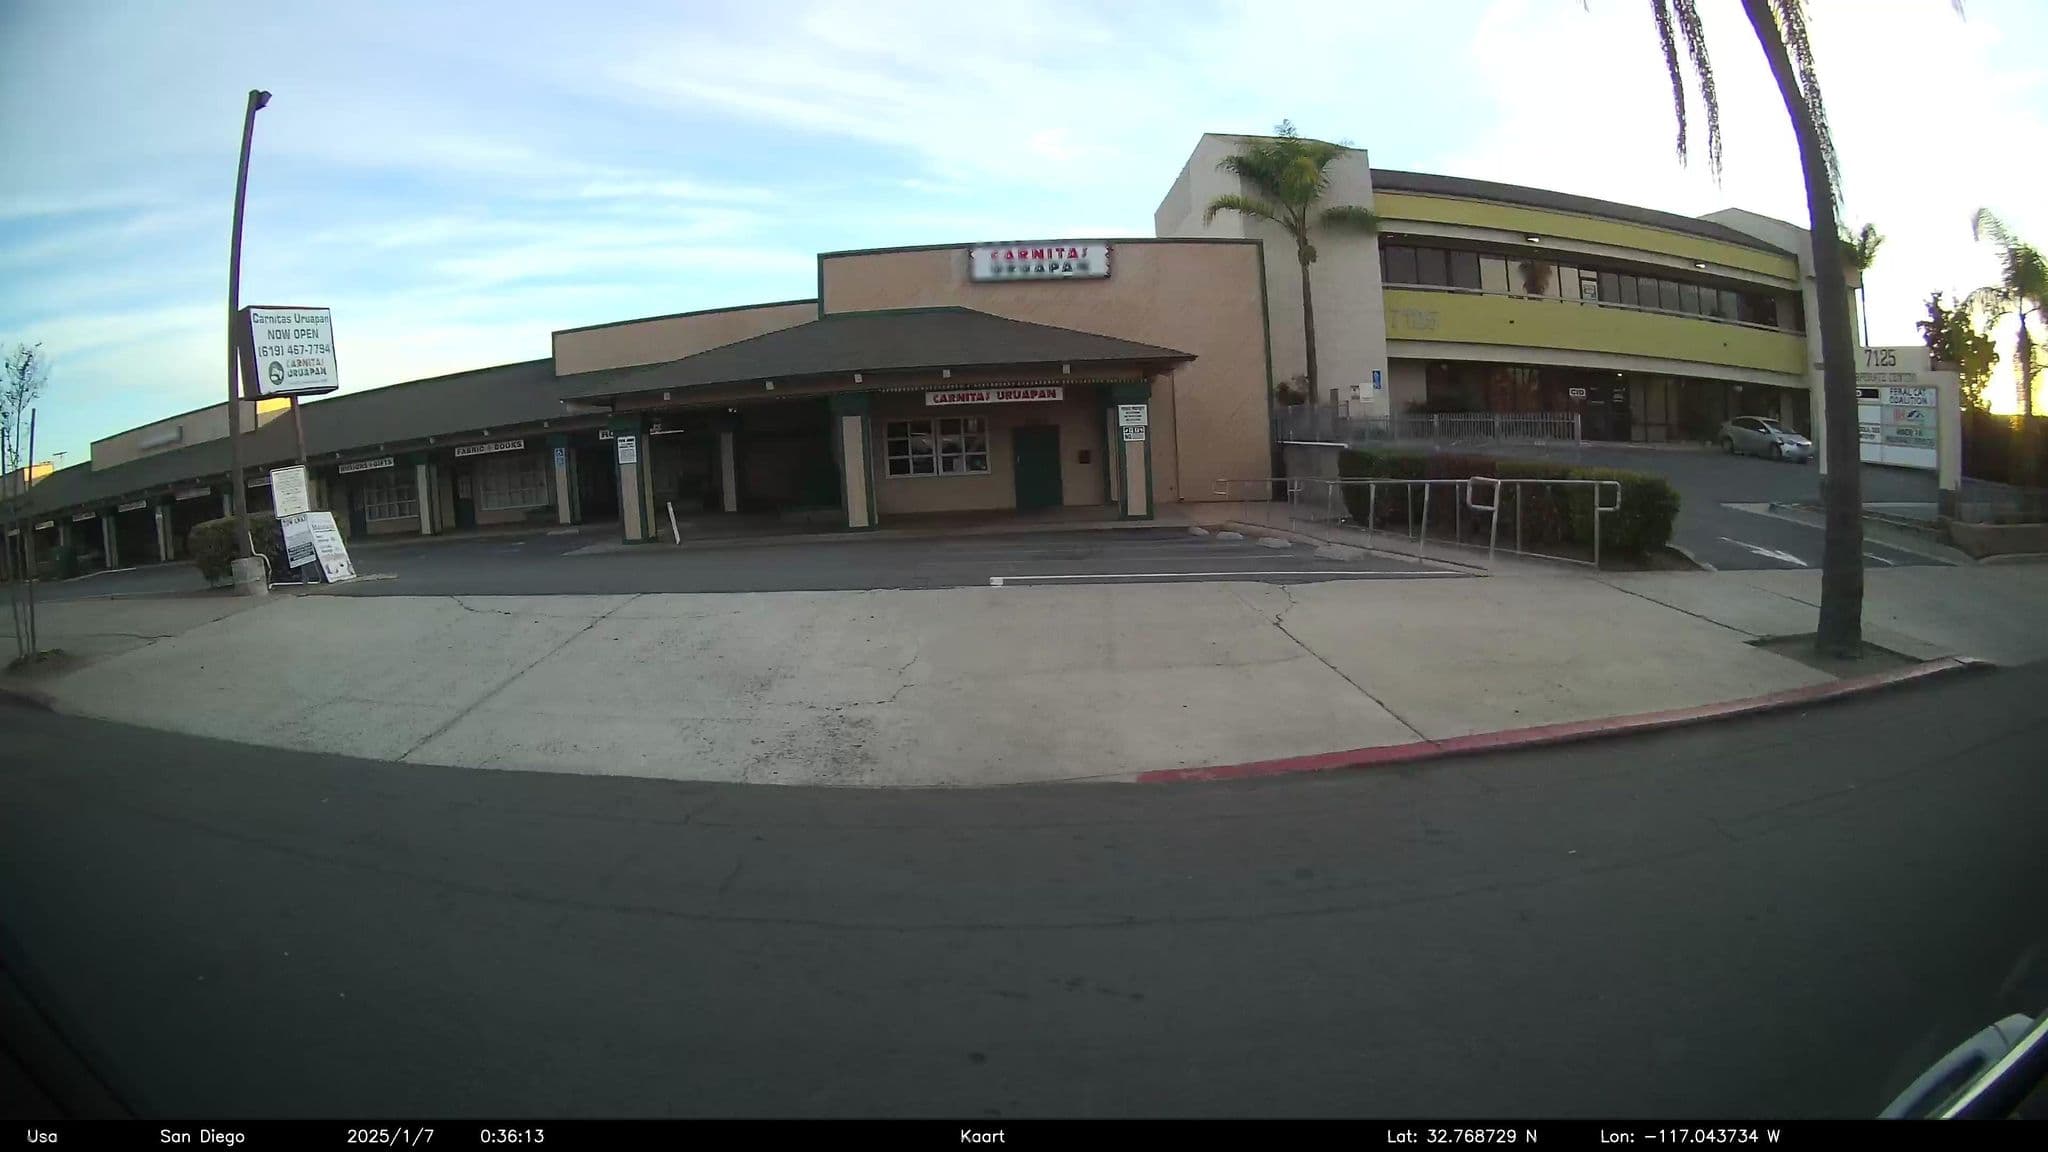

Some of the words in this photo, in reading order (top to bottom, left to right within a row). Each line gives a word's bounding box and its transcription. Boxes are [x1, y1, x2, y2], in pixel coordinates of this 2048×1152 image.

[252, 313, 292, 324] Carnitas
[293, 313, 330, 325] Uruapan
[267, 329, 291, 340] NOW
[293, 328, 319, 339] OPEN
[258, 345, 284, 357] (619)
[1864, 349, 1897, 367] 7125
[287, 367, 327, 378] URUAPAN
[932, 392, 991, 404] CARNITAS
[997, 389, 1057, 400] URUAPAN
